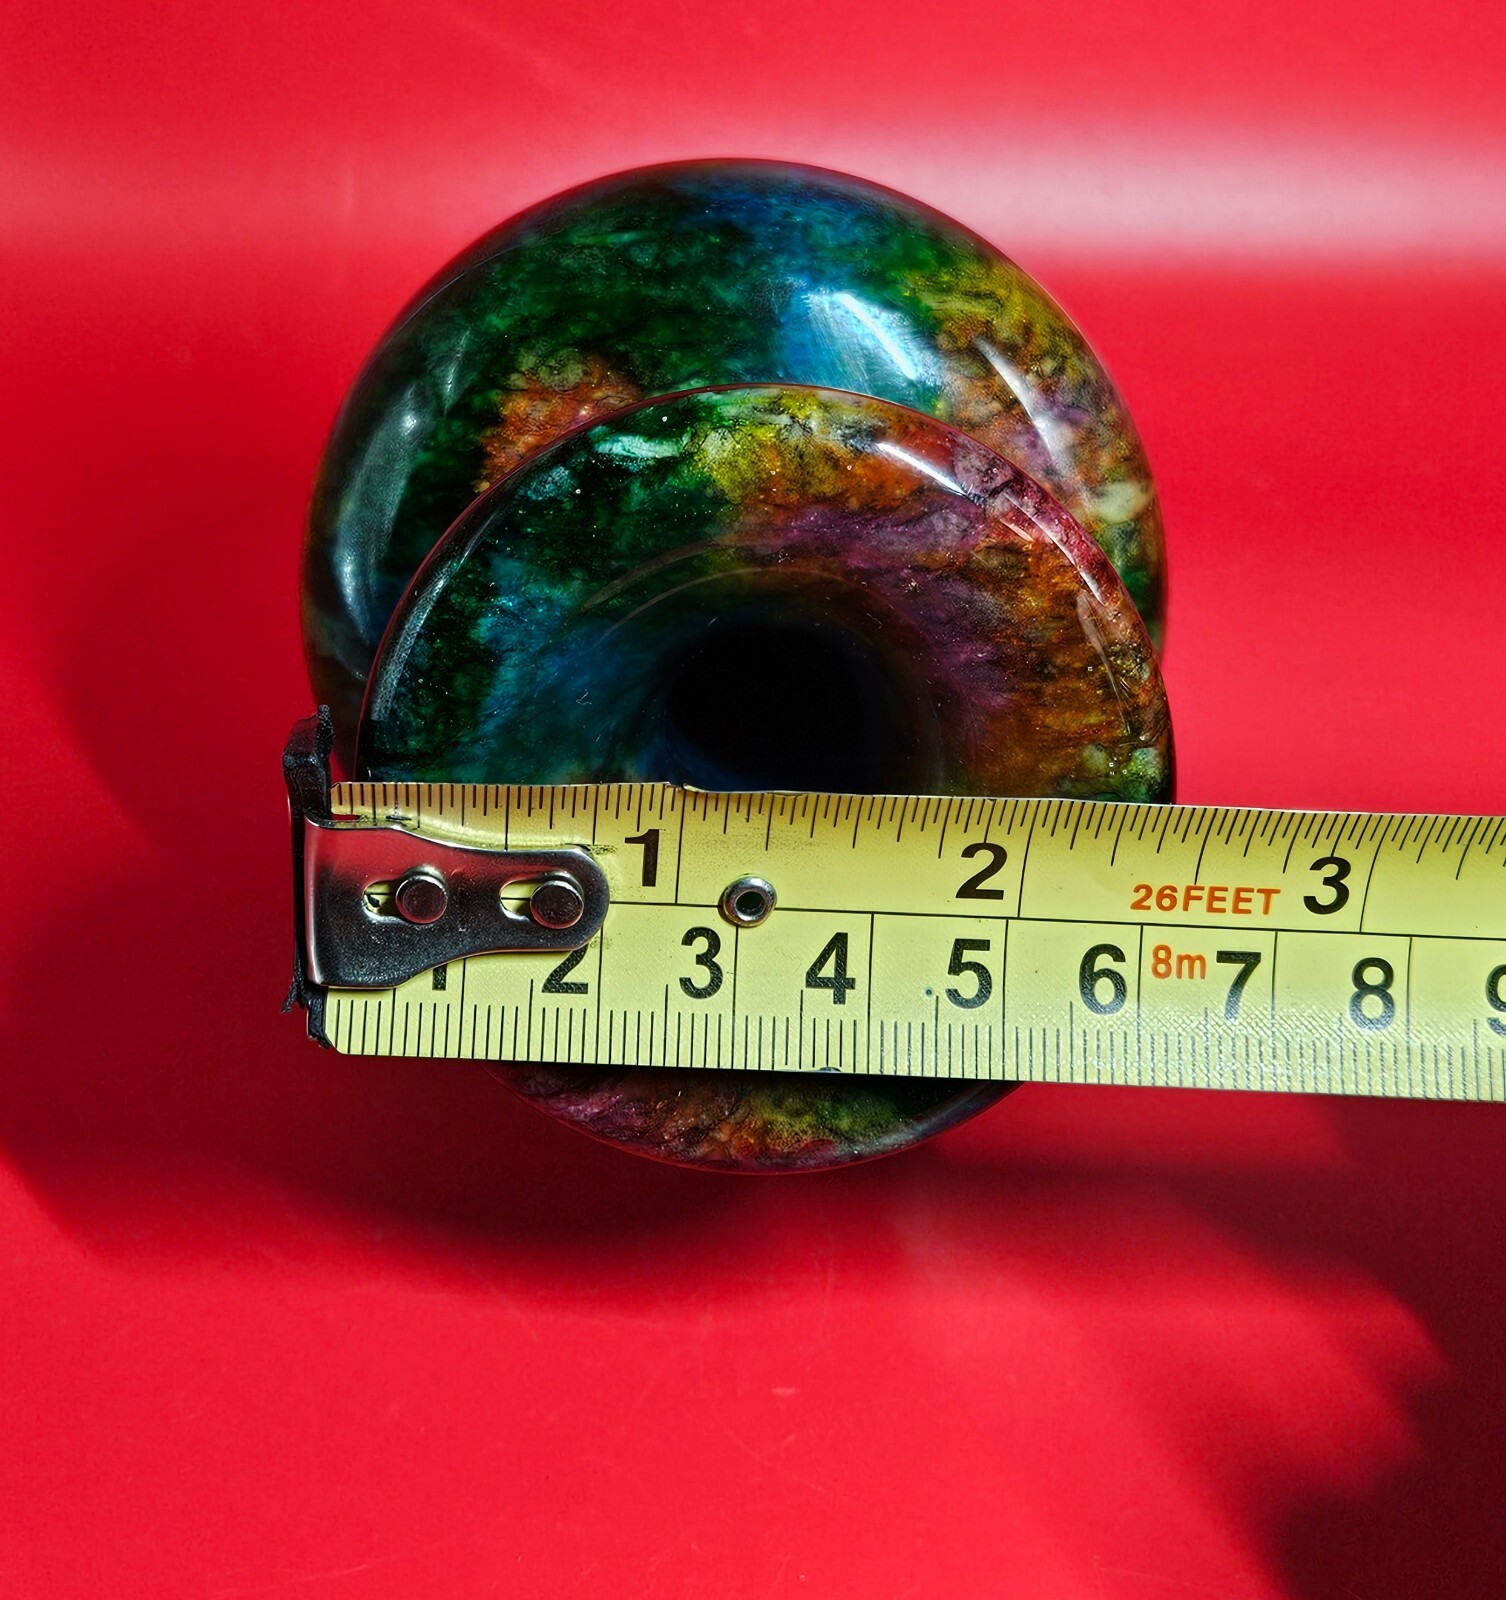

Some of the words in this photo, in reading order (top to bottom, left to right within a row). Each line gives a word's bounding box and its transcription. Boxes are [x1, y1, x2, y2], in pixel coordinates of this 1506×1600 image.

[624, 828, 659, 887] 1
[955, 842, 1008, 901] 2
[1303, 856, 1351, 915] 3
[1129, 883, 1281, 916] 26FEET
[679, 926, 723, 999] 3
[805, 931, 856, 1004] 4
[945, 937, 992, 1010] 5
[1078, 943, 1127, 1016] 6
[1151, 944, 1207, 981] 8m
[1215, 950, 1262, 1022] 7
[1349, 957, 1396, 1031] 8
